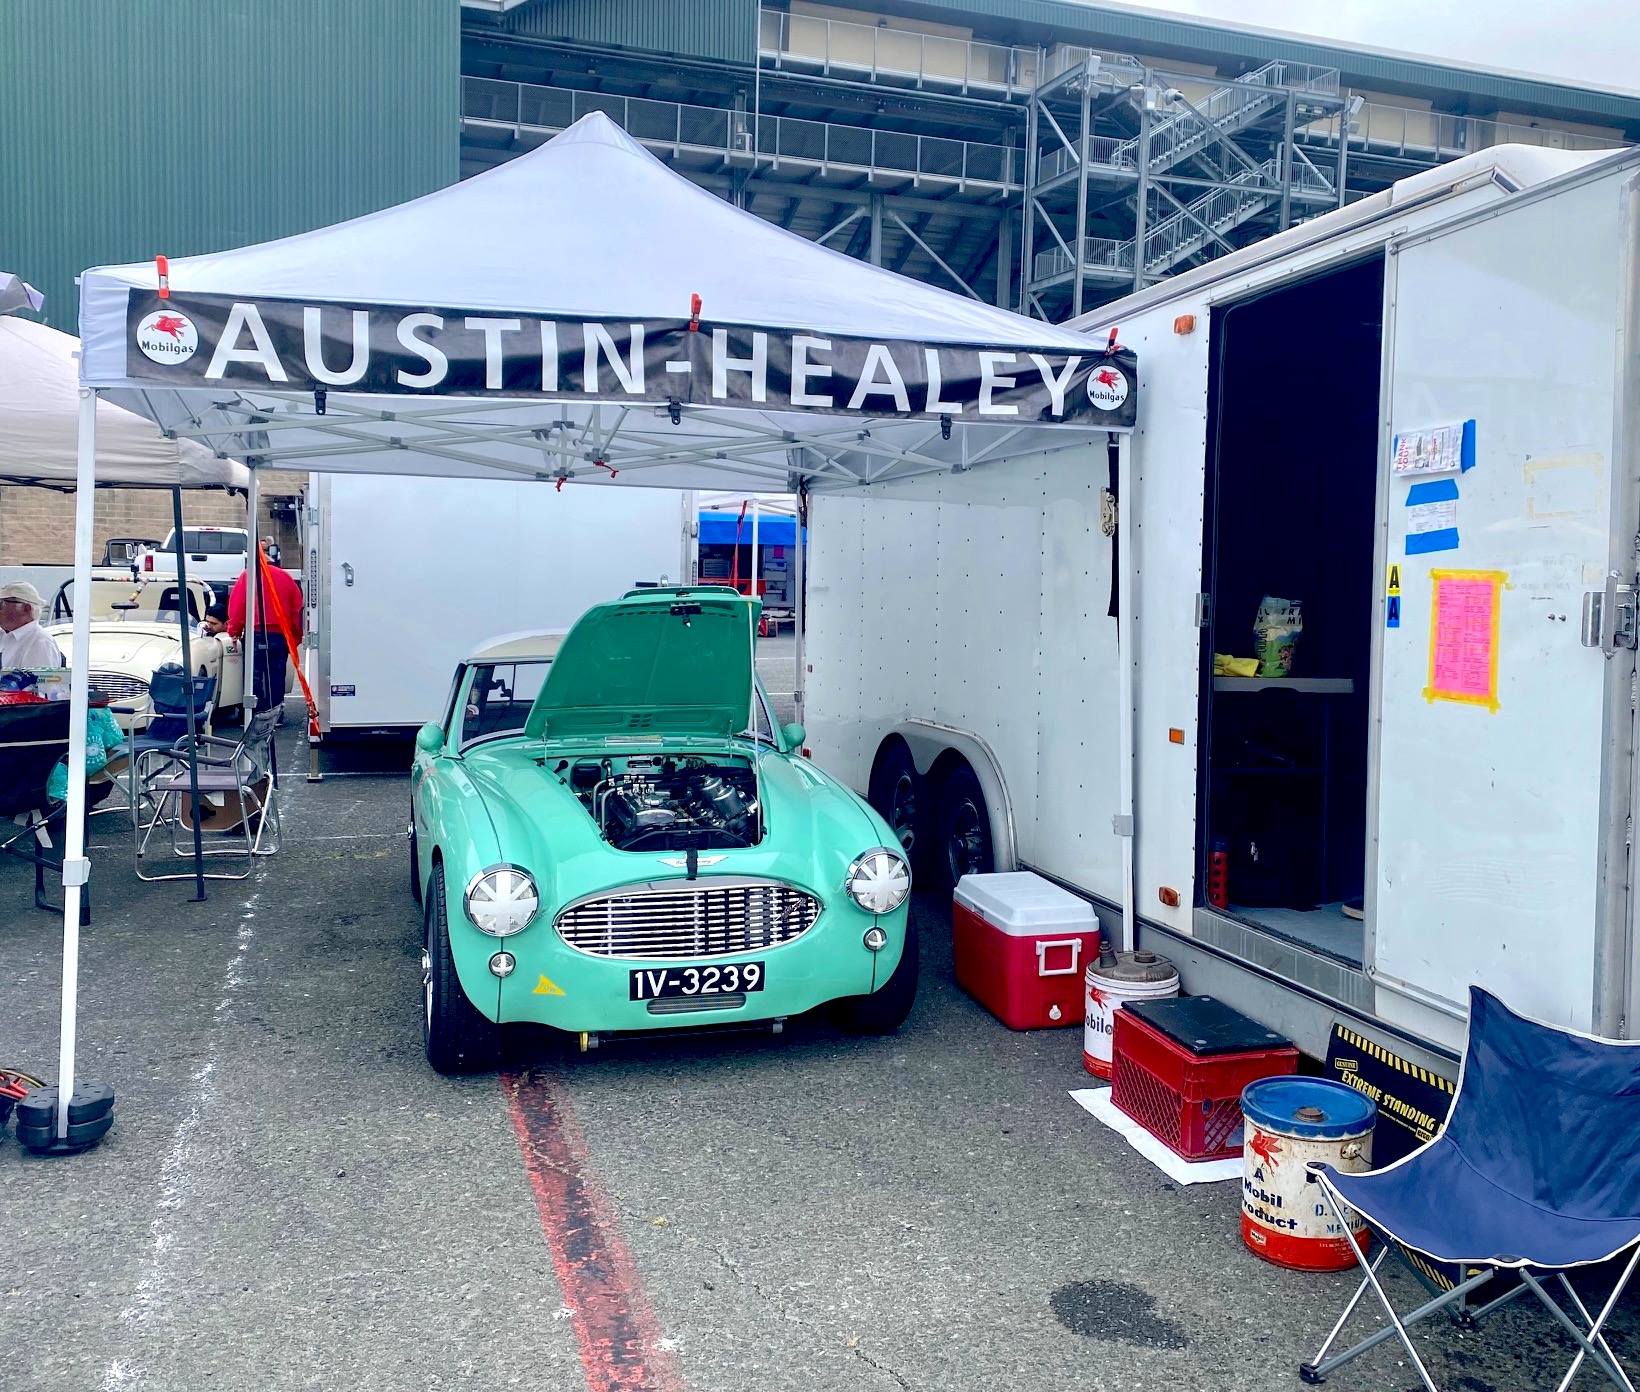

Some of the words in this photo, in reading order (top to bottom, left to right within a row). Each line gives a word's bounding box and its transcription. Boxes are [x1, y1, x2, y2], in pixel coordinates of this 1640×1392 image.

[141, 340, 194, 355] Mobilgas
[204, 302, 1083, 416] AUSTIN-HEALEY
[1089, 390, 1125, 403] Mobilgas
[1389, 566, 1400, 588] A
[1388, 597, 1399, 620] A
[1341, 1070, 1383, 1102] EXTREME
[1382, 1094, 1436, 1131] STANDING
[1254, 1167, 1265, 1182] A
[1245, 1177, 1283, 1208] Mobil
[1243, 1199, 1298, 1230] roduct
